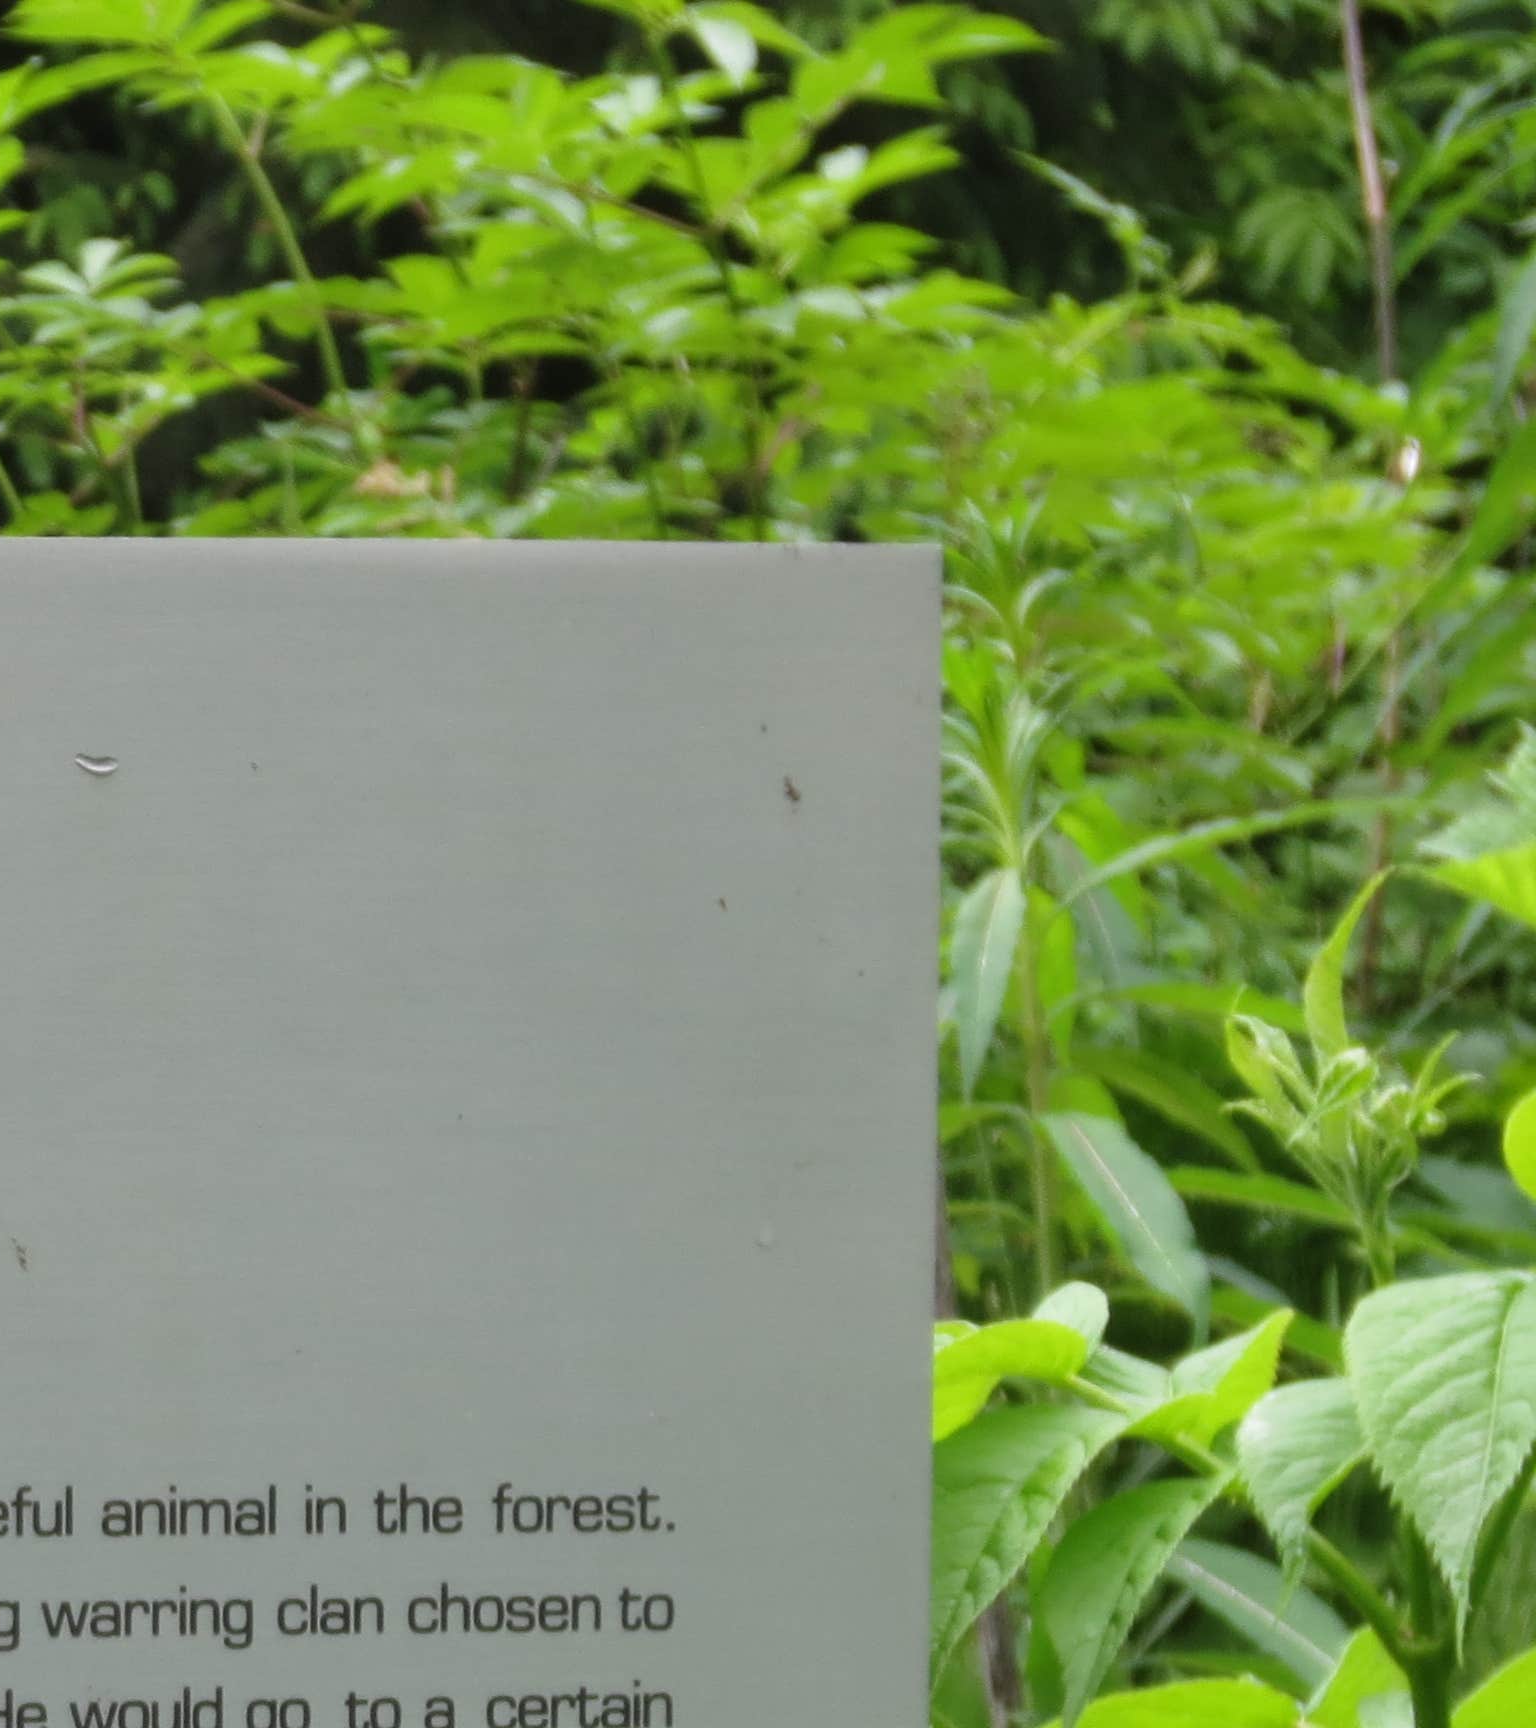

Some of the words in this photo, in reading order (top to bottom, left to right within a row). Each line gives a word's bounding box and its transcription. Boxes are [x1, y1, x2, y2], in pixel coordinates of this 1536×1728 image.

[100, 1483, 277, 1538] animal
[304, 1484, 347, 1535] in
[373, 1482, 464, 1536] the
[491, 1482, 676, 1534] forest.
[40, 1585, 254, 1651] warring
[276, 1583, 385, 1637] clan
[407, 1581, 602, 1635] chosen
[618, 1587, 675, 1633] to
